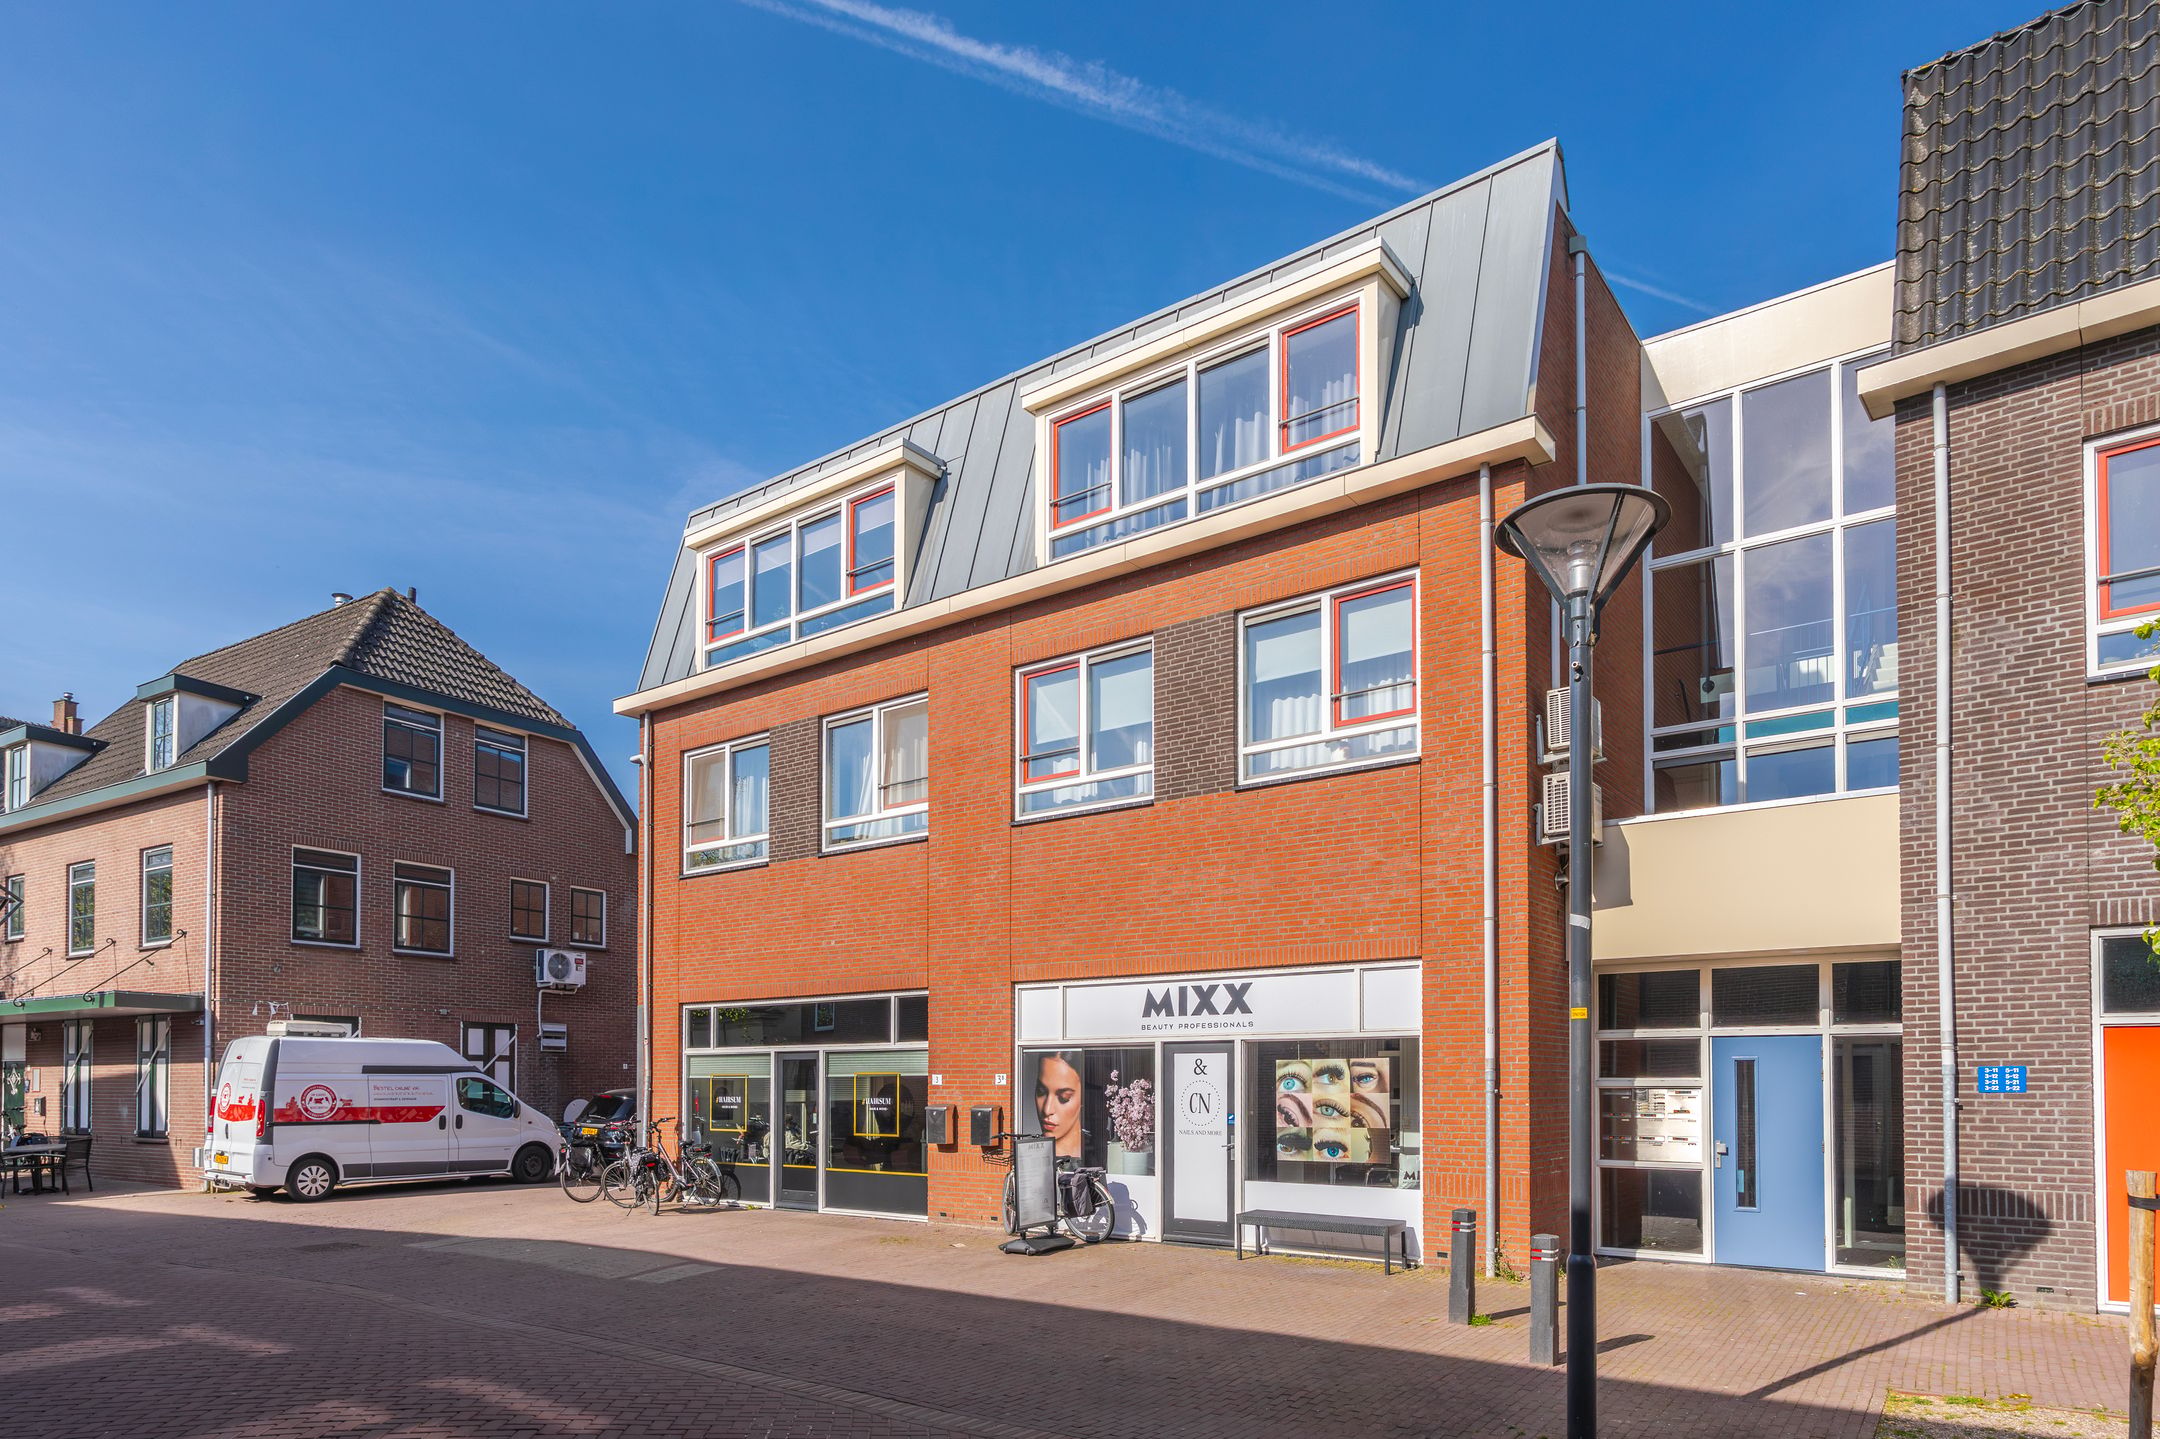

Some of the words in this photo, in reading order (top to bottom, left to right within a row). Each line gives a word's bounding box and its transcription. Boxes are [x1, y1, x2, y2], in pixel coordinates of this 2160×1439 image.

[1141, 982, 1253, 1018] MIXX
[1141, 1023, 1174, 1031] BEAUTY
[1178, 1021, 1254, 1030] PROFESSIONALS
[1193, 1058, 1208, 1076] &
[1189, 1092, 1211, 1114] CN
